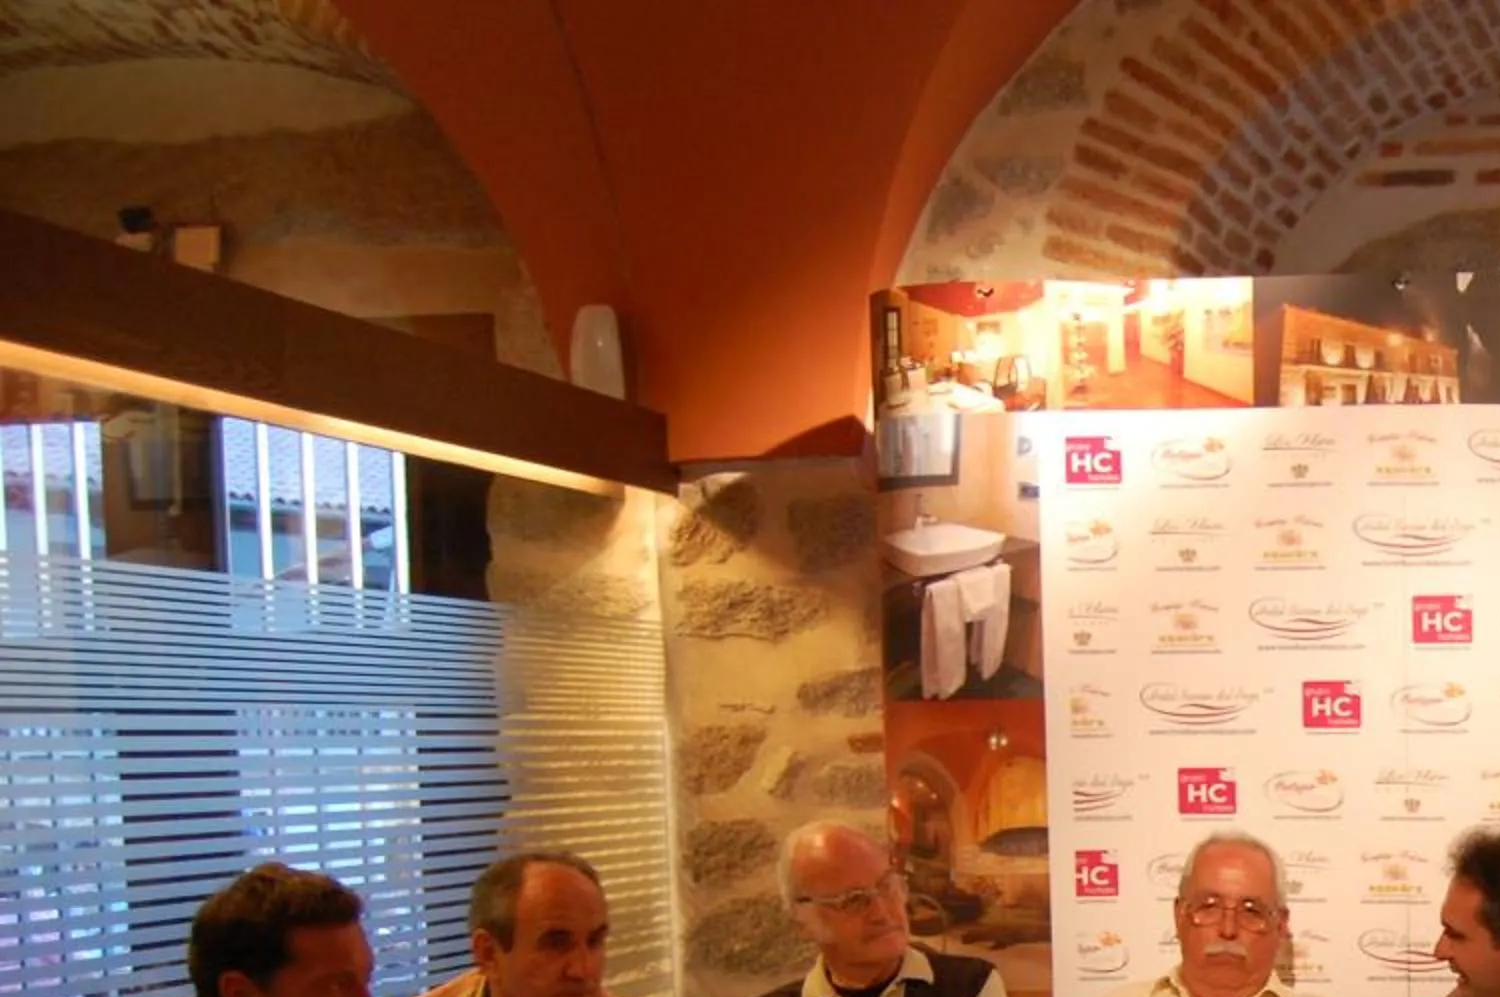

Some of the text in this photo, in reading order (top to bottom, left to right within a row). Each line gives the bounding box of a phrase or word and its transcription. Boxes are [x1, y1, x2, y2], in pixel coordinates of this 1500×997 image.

[1071, 451, 1113, 473] HC
[1422, 612, 1463, 632] HC
[1311, 696, 1352, 717] HC
[1187, 783, 1227, 803] HC
